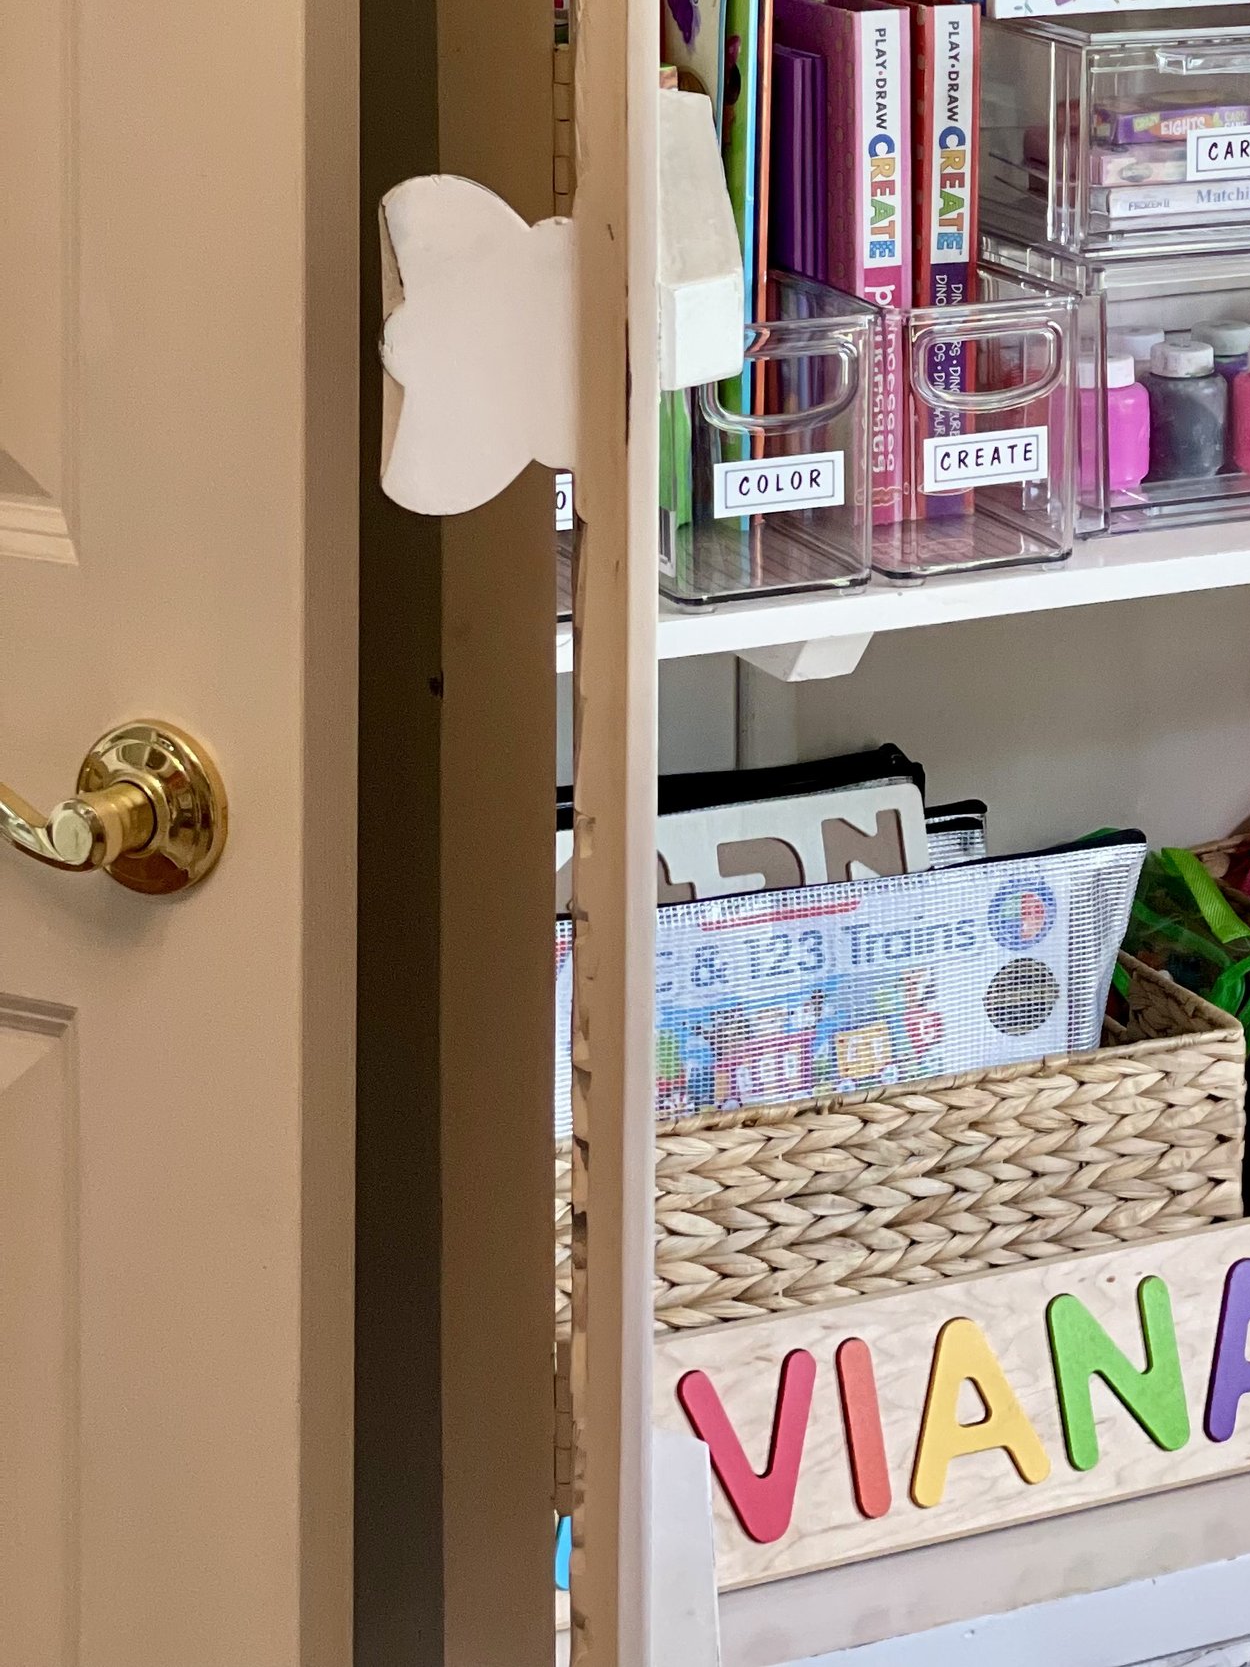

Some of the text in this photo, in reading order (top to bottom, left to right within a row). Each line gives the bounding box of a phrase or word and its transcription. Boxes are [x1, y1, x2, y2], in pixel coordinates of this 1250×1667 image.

[1160, 116, 1206, 135] EIGHTS
[1224, 109, 1247, 122] CARD
[868, 133, 896, 259] CREATE
[937, 125, 966, 251] CREATE
[940, 442, 1033, 472] CREATE
[738, 468, 821, 496] COLOR
[690, 945, 729, 988] &
[743, 929, 826, 979] 123
[840, 916, 977, 966] Trains
